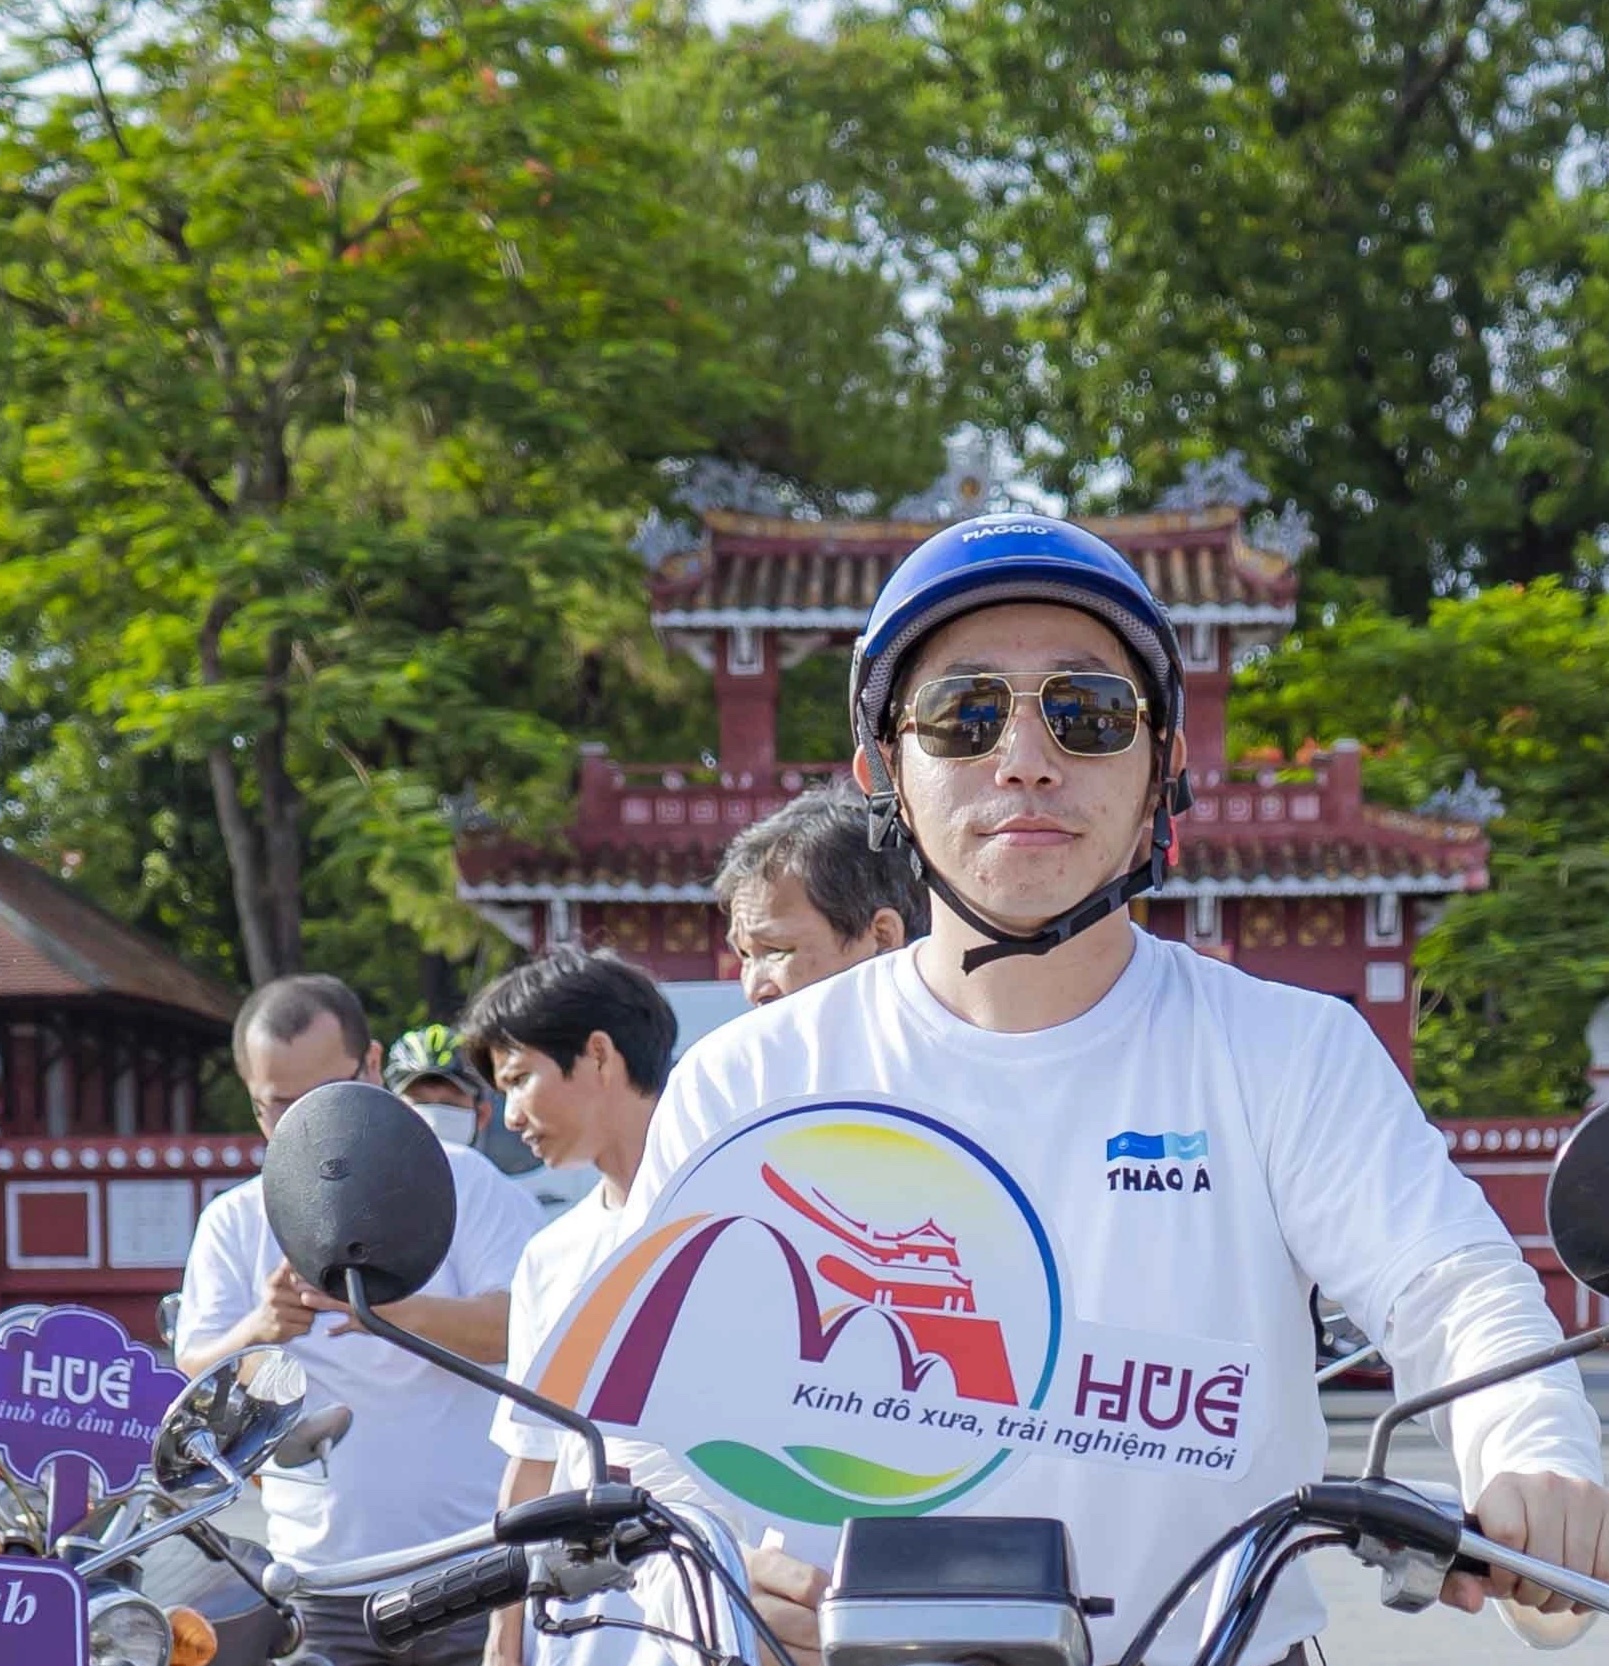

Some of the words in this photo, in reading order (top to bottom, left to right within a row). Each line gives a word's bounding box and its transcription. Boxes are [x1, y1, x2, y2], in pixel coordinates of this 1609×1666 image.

[961, 524, 1048, 543] PIAGGIO
[22, 1350, 134, 1410] HUẾ
[1074, 1353, 1250, 1438] HUẾ
[42, 1404, 72, 1428] đô
[792, 1383, 863, 1414] Kinh
[872, 1390, 911, 1422] đô
[921, 1407, 985, 1436] xưa,
[996, 1410, 1045, 1444] trải
[1053, 1428, 1168, 1461] nghiệm
[1176, 1444, 1237, 1471] mới
